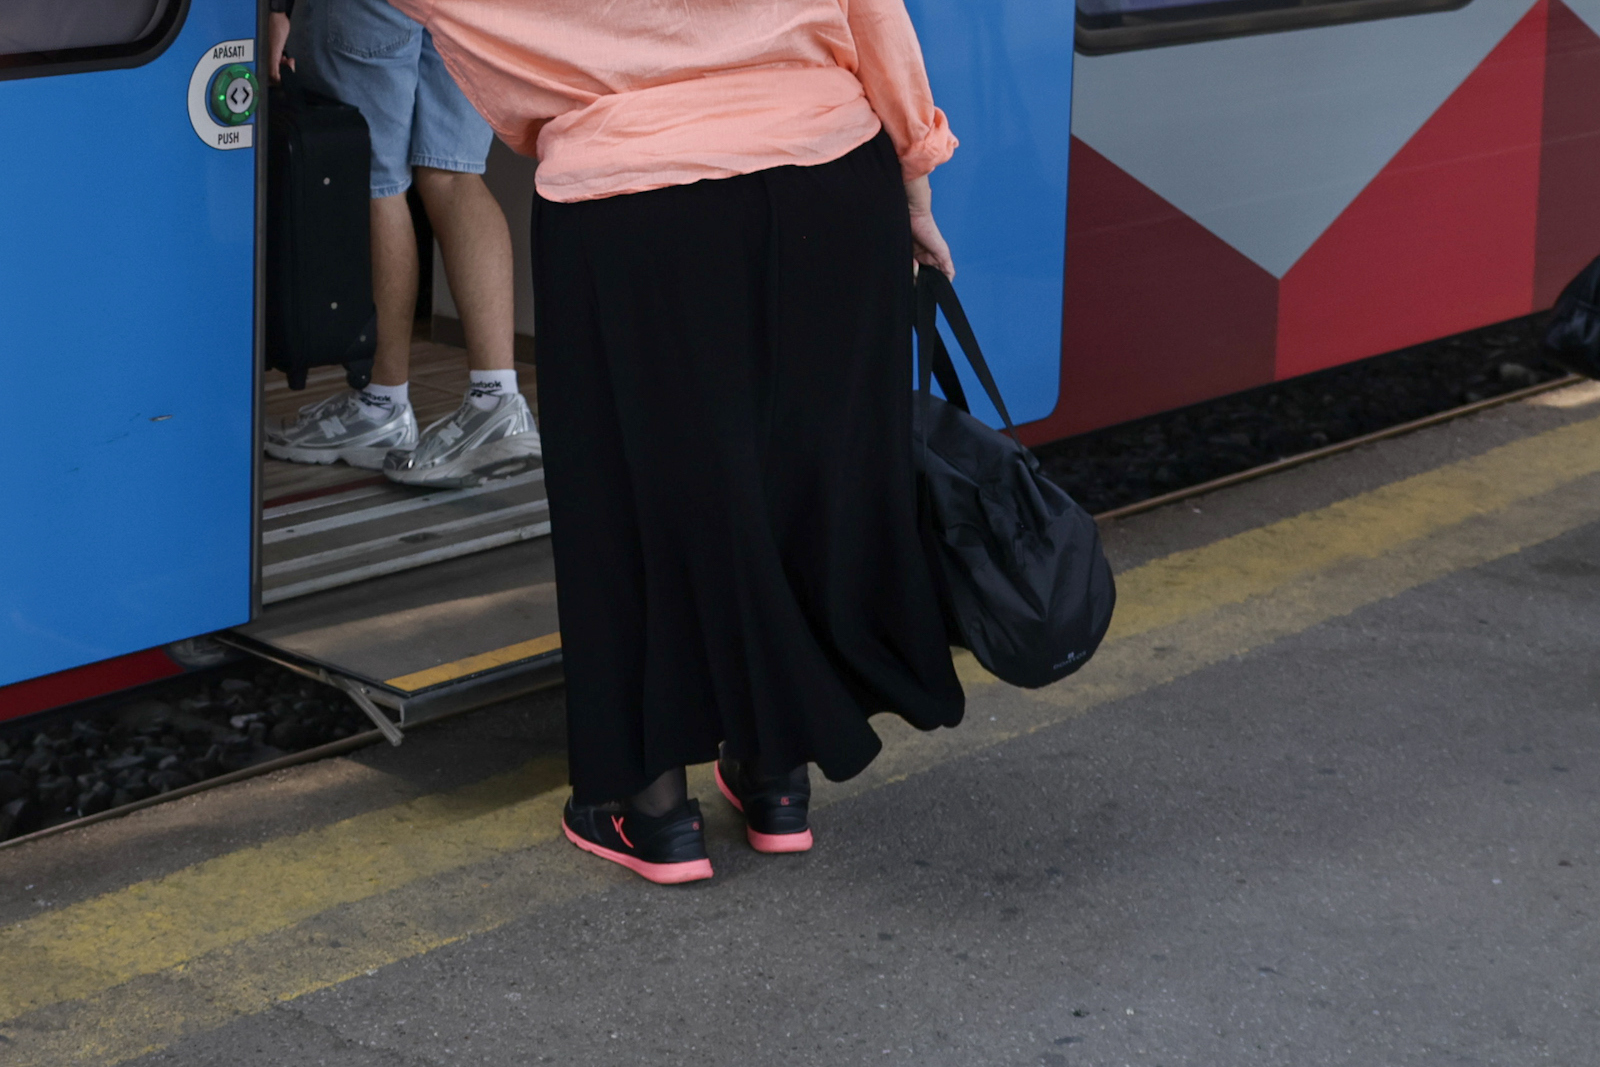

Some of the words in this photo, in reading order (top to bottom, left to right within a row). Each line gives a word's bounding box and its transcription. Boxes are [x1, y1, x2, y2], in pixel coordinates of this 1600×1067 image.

[217, 132, 240, 145] PUSH
[318, 415, 347, 439] N
[438, 420, 464, 446] N
